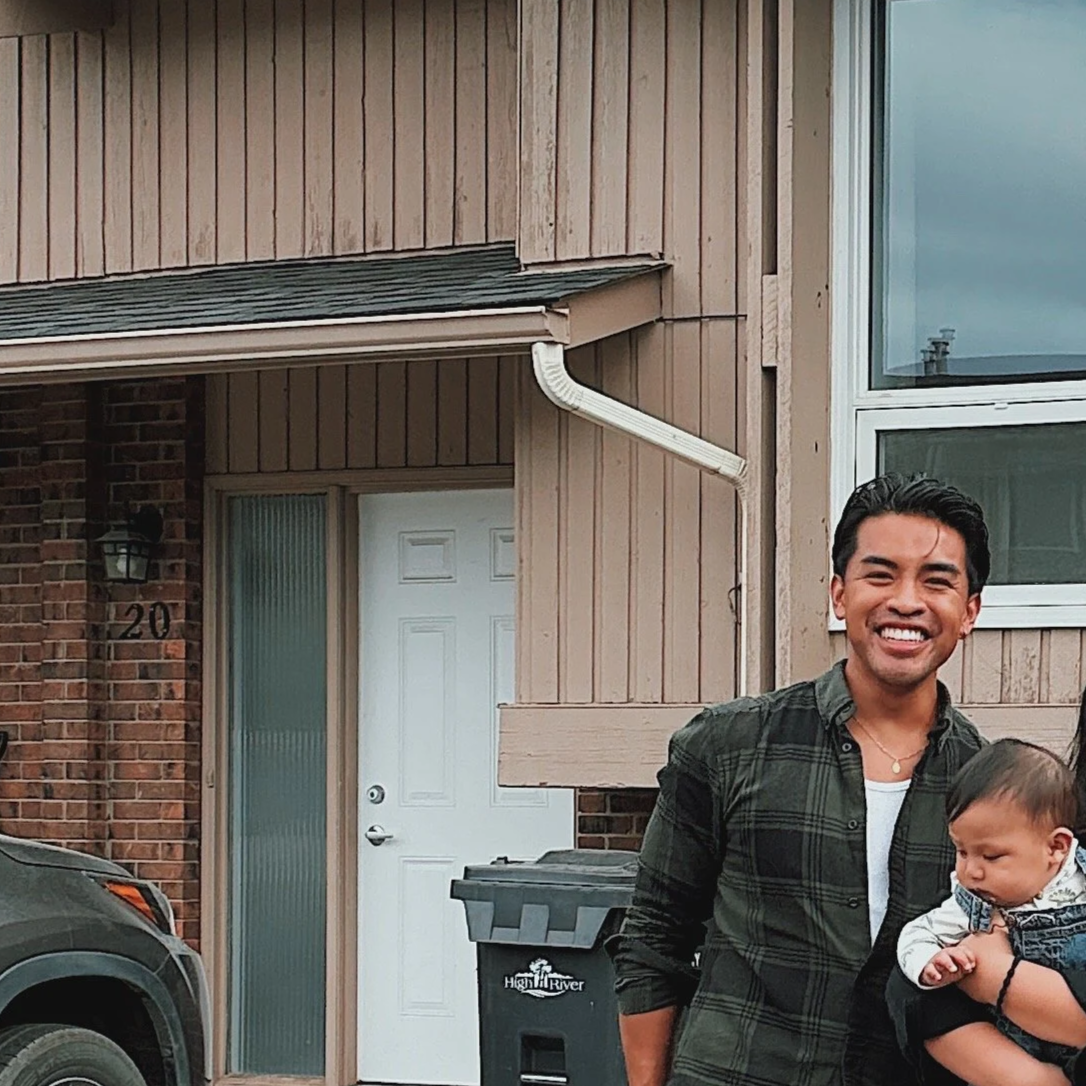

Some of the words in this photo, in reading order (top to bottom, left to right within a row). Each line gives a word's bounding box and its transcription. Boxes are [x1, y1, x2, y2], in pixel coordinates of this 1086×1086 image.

[119, 602, 170, 639] 20
[504, 976, 533, 992] High
[549, 978, 585, 992] River
